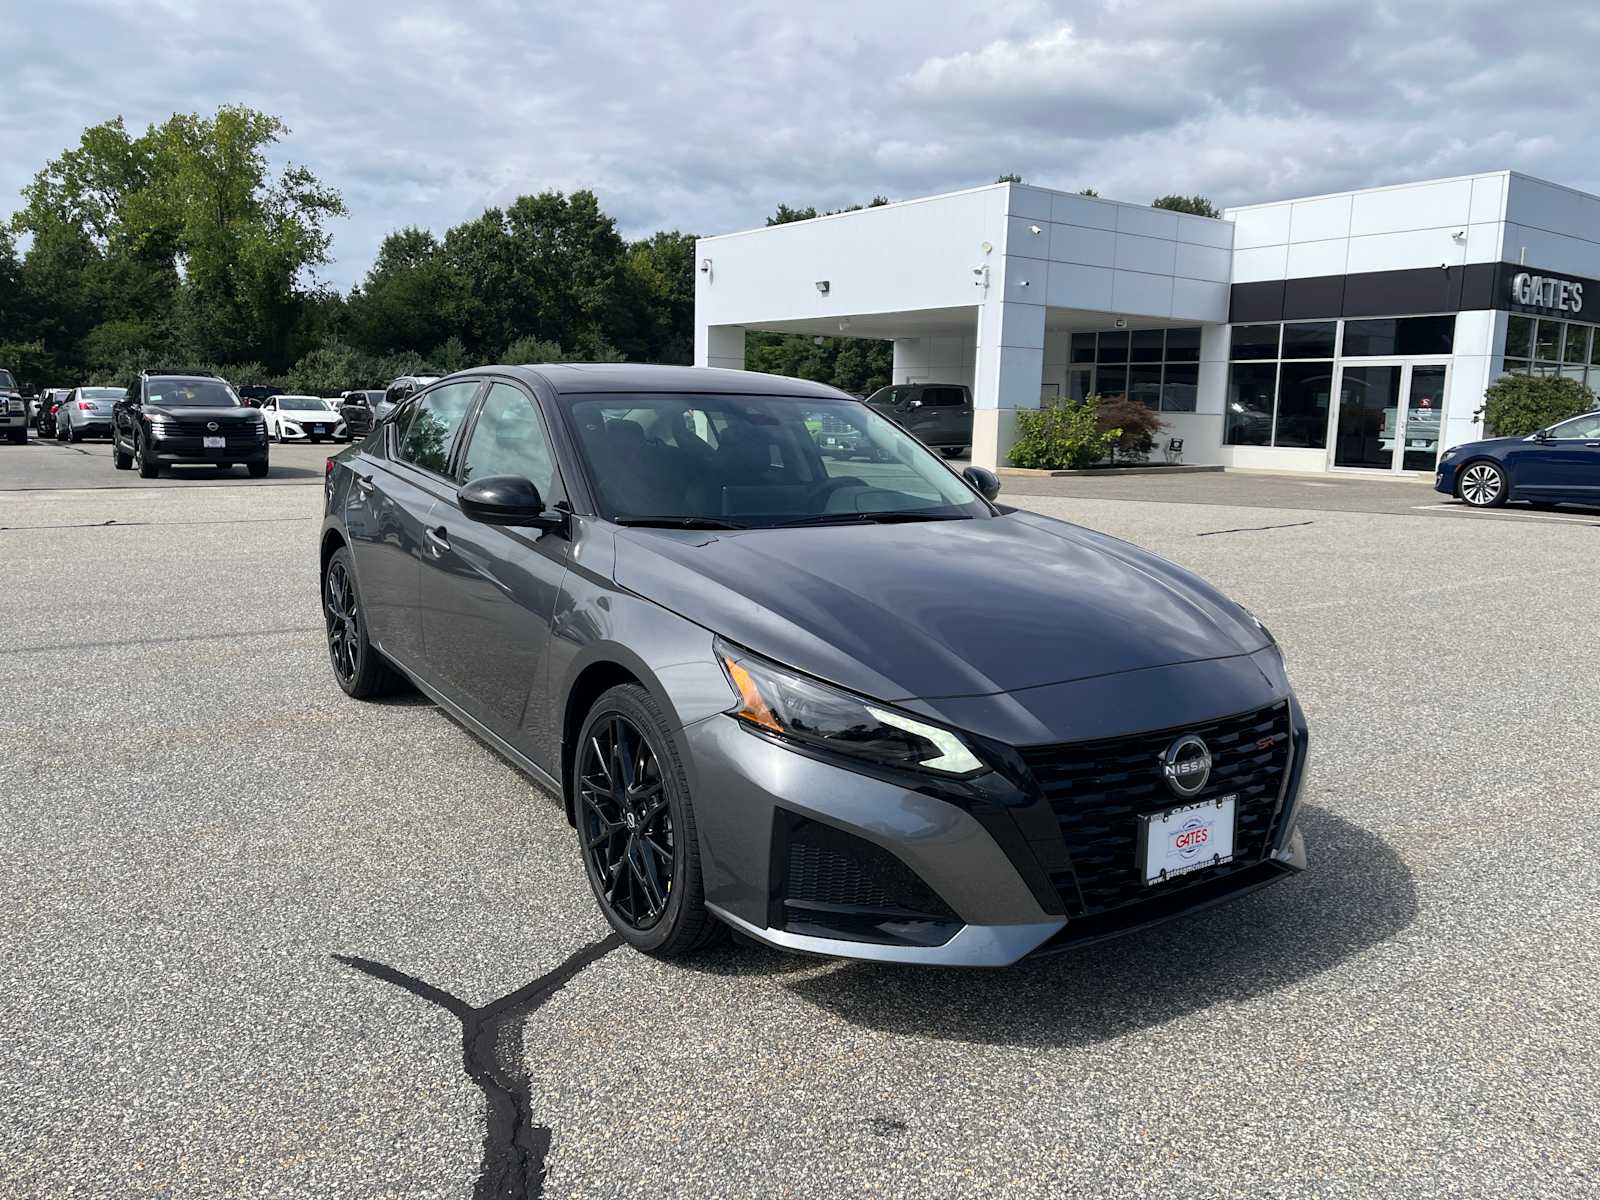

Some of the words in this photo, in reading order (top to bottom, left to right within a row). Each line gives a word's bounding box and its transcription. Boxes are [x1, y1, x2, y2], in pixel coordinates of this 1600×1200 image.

[1513, 273, 1583, 312] GATES
[1257, 736, 1275, 749] SR
[1165, 754, 1212, 776] NISSAN
[1176, 829, 1208, 848] GATES
